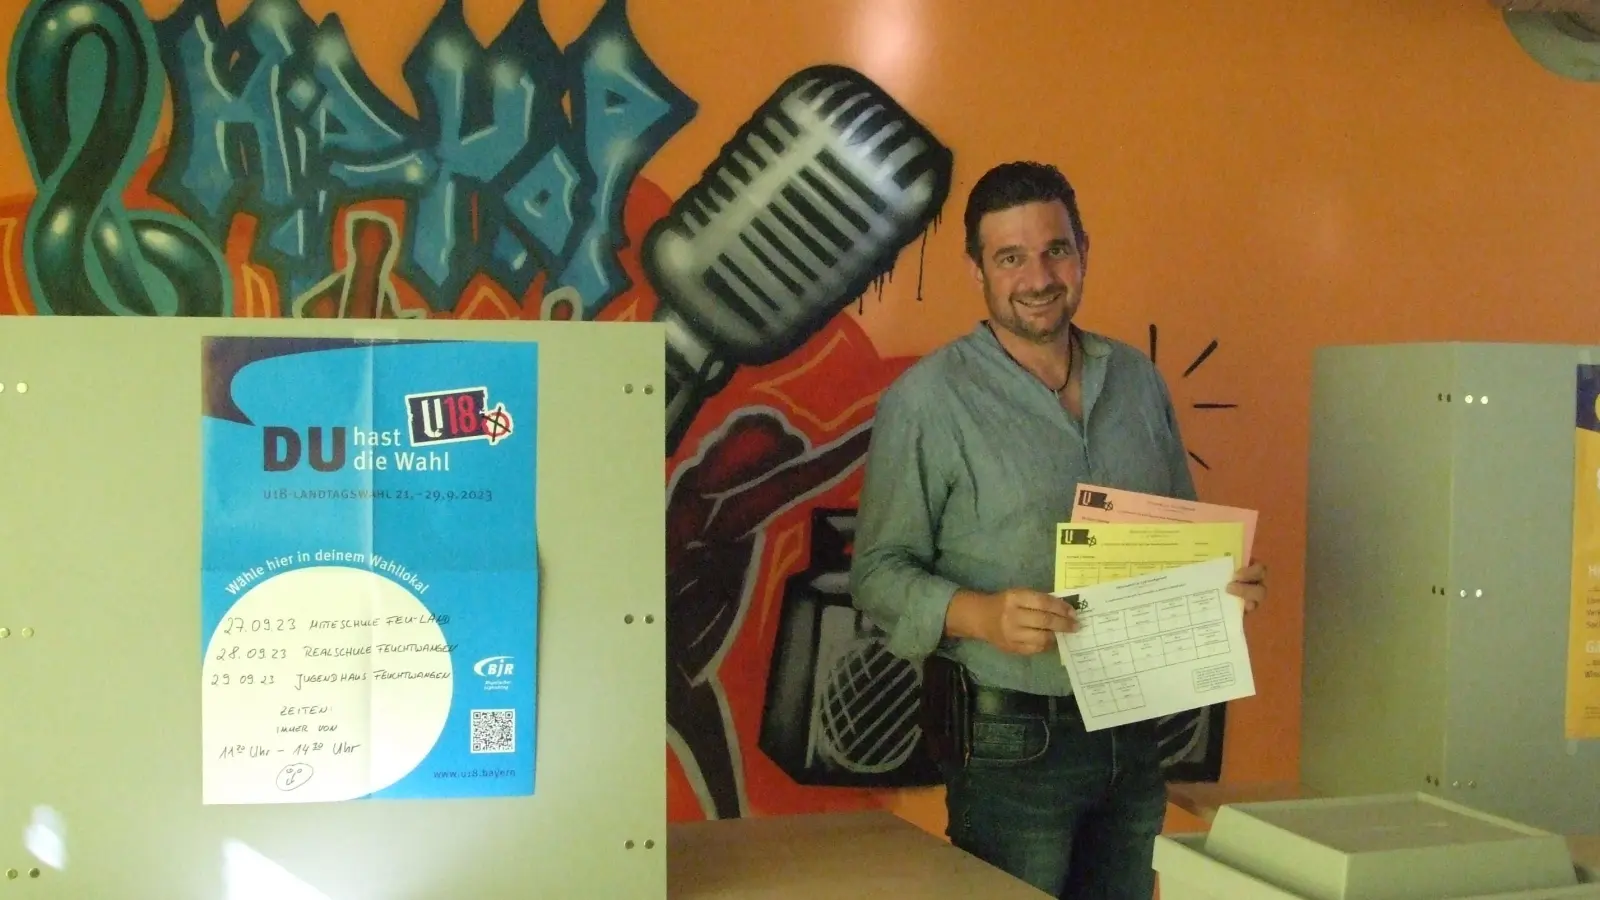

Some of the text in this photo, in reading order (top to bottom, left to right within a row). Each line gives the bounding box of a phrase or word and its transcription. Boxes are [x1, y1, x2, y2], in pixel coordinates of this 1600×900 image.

[421, 395, 477, 438] U18
[263, 426, 401, 472] DU hast
[353, 450, 450, 471] die Wahl
[263, 489, 392, 500] U18-LANDTAGSWAHL
[225, 549, 429, 595] Wähle hier in deinem Wahllokal
